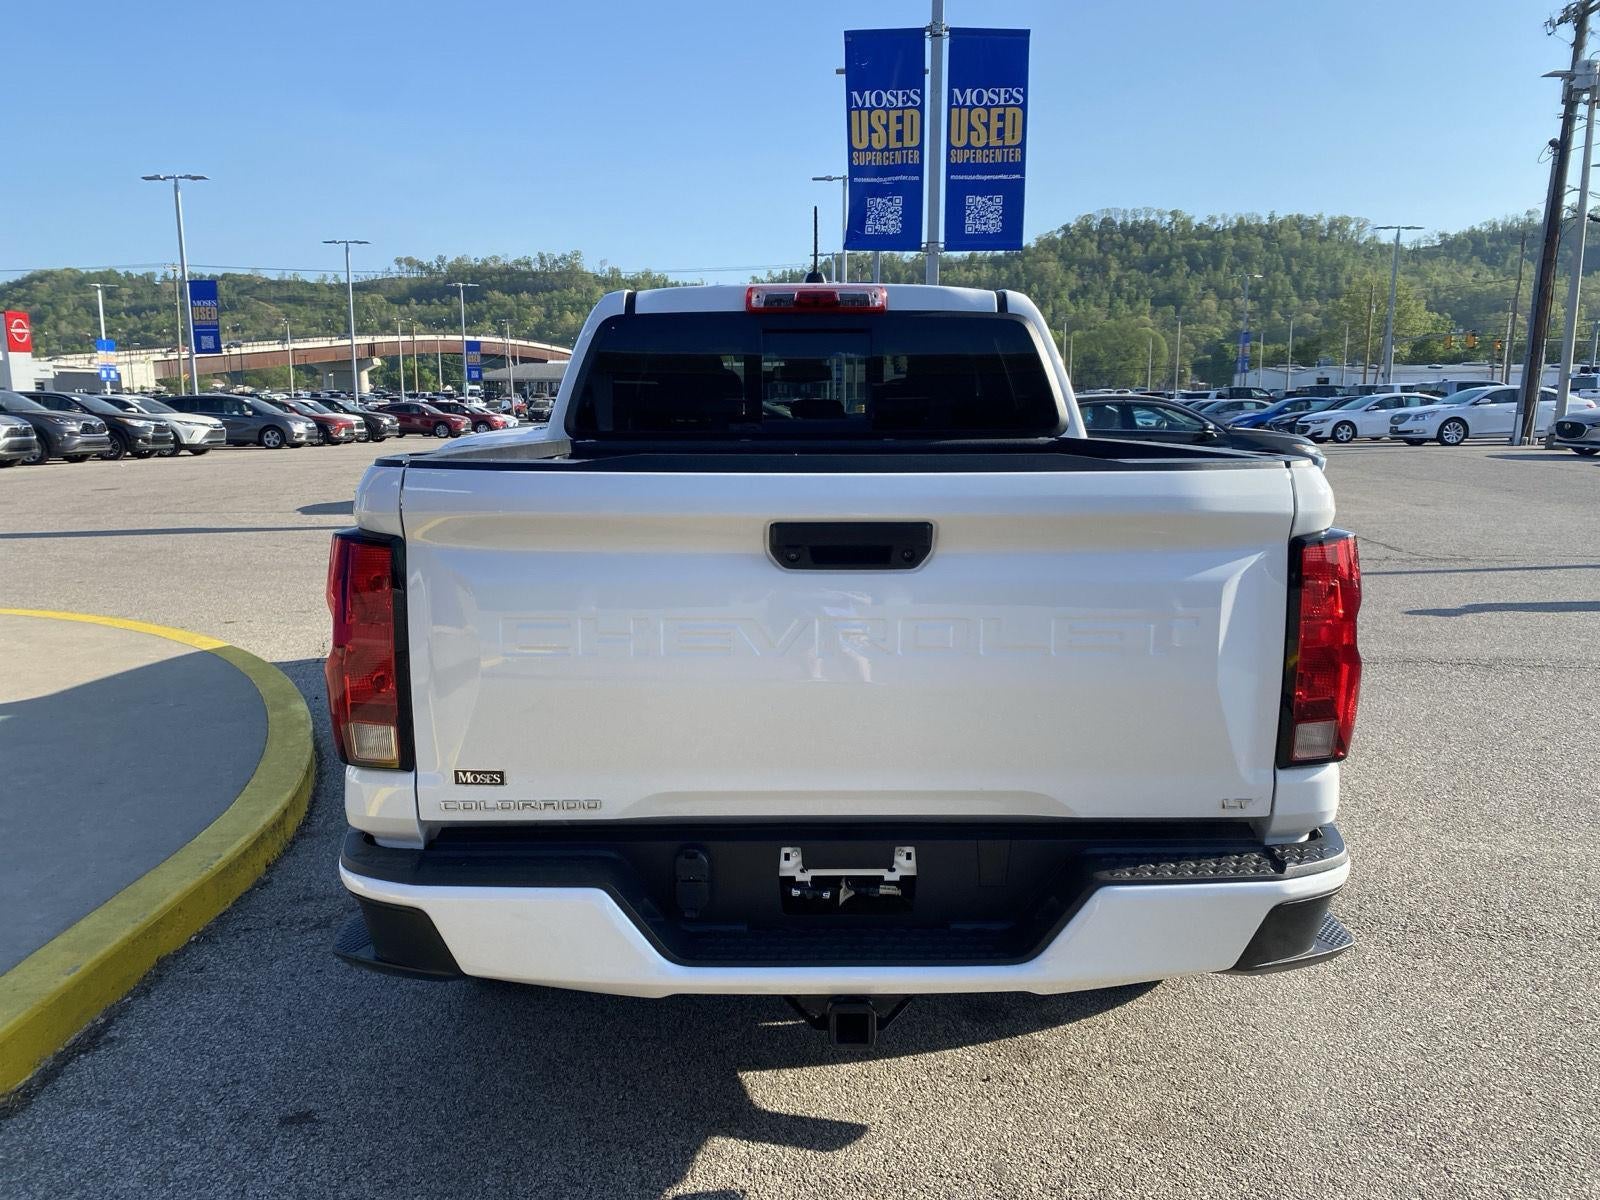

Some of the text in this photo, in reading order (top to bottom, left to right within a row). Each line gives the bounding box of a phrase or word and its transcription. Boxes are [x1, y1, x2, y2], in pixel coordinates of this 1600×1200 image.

[851, 89, 921, 108] MOSES
[952, 88, 1023, 106] MOSES
[851, 109, 921, 150] USED
[951, 107, 1023, 147] USED
[852, 149, 920, 166] SUPERCENTER
[950, 148, 1021, 164] SUPERCENTER
[193, 307, 217, 320] USED
[498, 615, 1200, 657] CHEVROLET
[439, 799, 602, 812] COLORADO
[1221, 798, 1253, 809] LT
